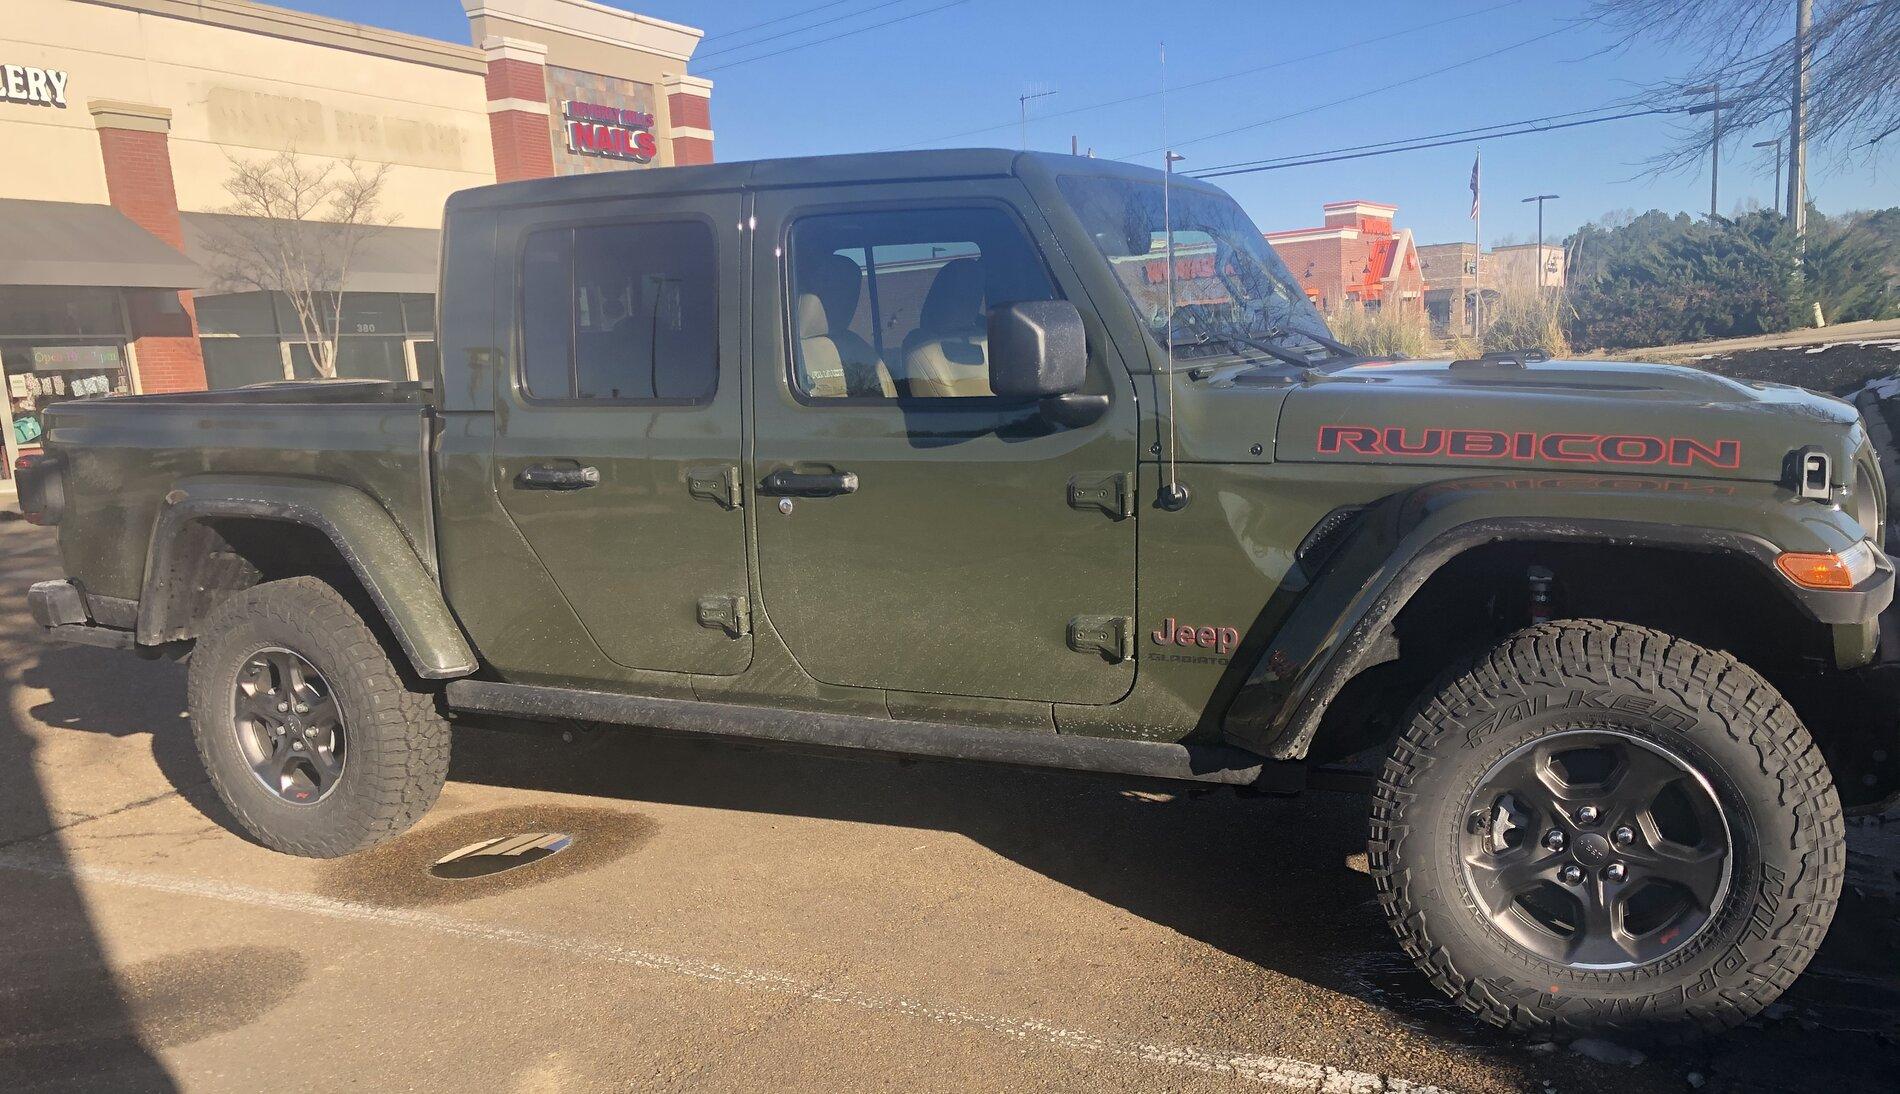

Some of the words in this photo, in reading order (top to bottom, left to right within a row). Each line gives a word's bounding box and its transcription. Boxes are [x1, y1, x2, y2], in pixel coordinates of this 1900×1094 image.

[570, 121, 657, 162] NAILS
[1317, 425, 1741, 469] RUBICON
[1151, 617, 1239, 654] Jeep
[1149, 653, 1230, 666] GLADIATO
[1461, 689, 1699, 749] FALKEN
